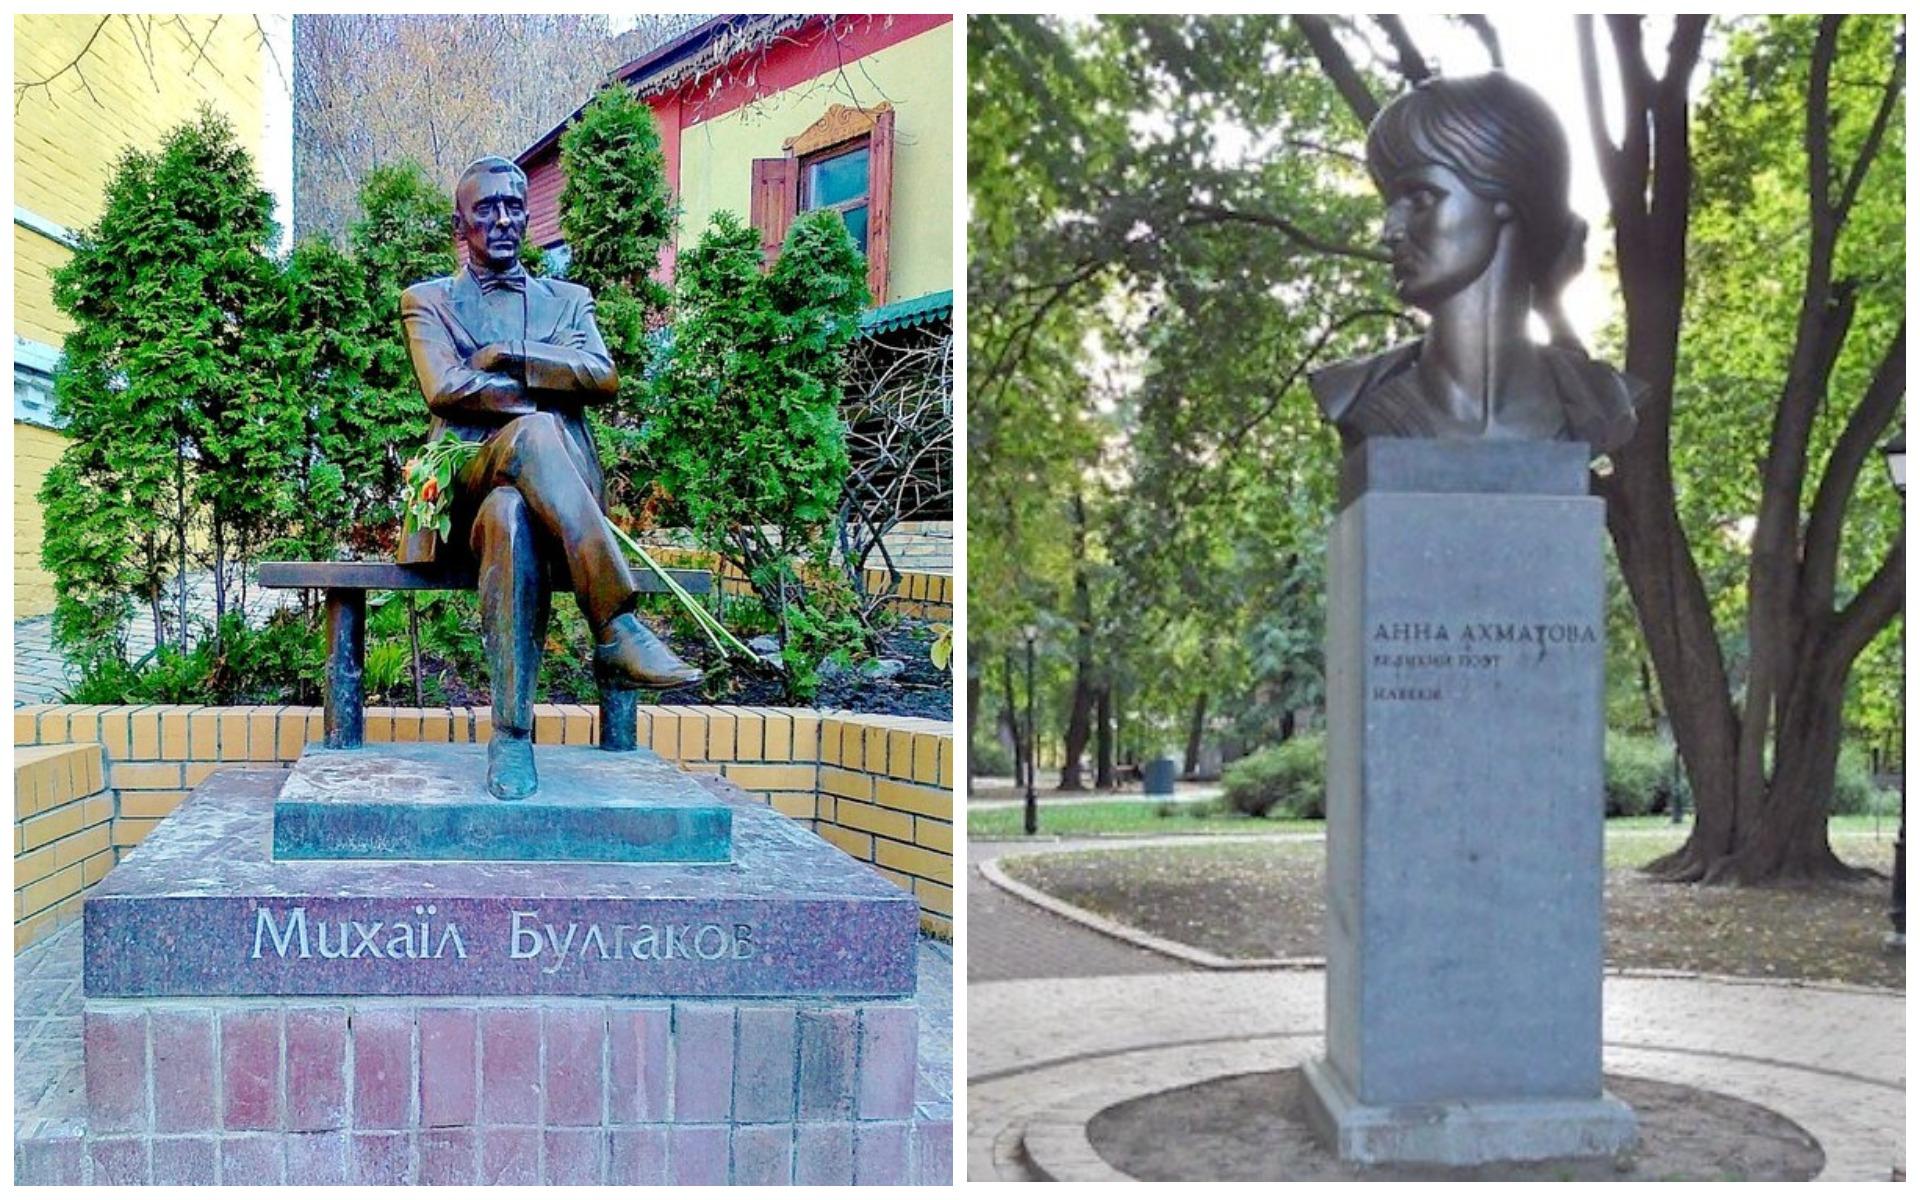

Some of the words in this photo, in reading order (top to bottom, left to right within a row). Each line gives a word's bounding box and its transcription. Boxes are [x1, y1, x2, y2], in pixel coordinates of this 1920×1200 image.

[1374, 623, 1449, 641] АННА
[1459, 623, 1598, 643] АХМАТОВА
[250, 904, 468, 961] Михаїл
[509, 909, 755, 975] Булгаков
